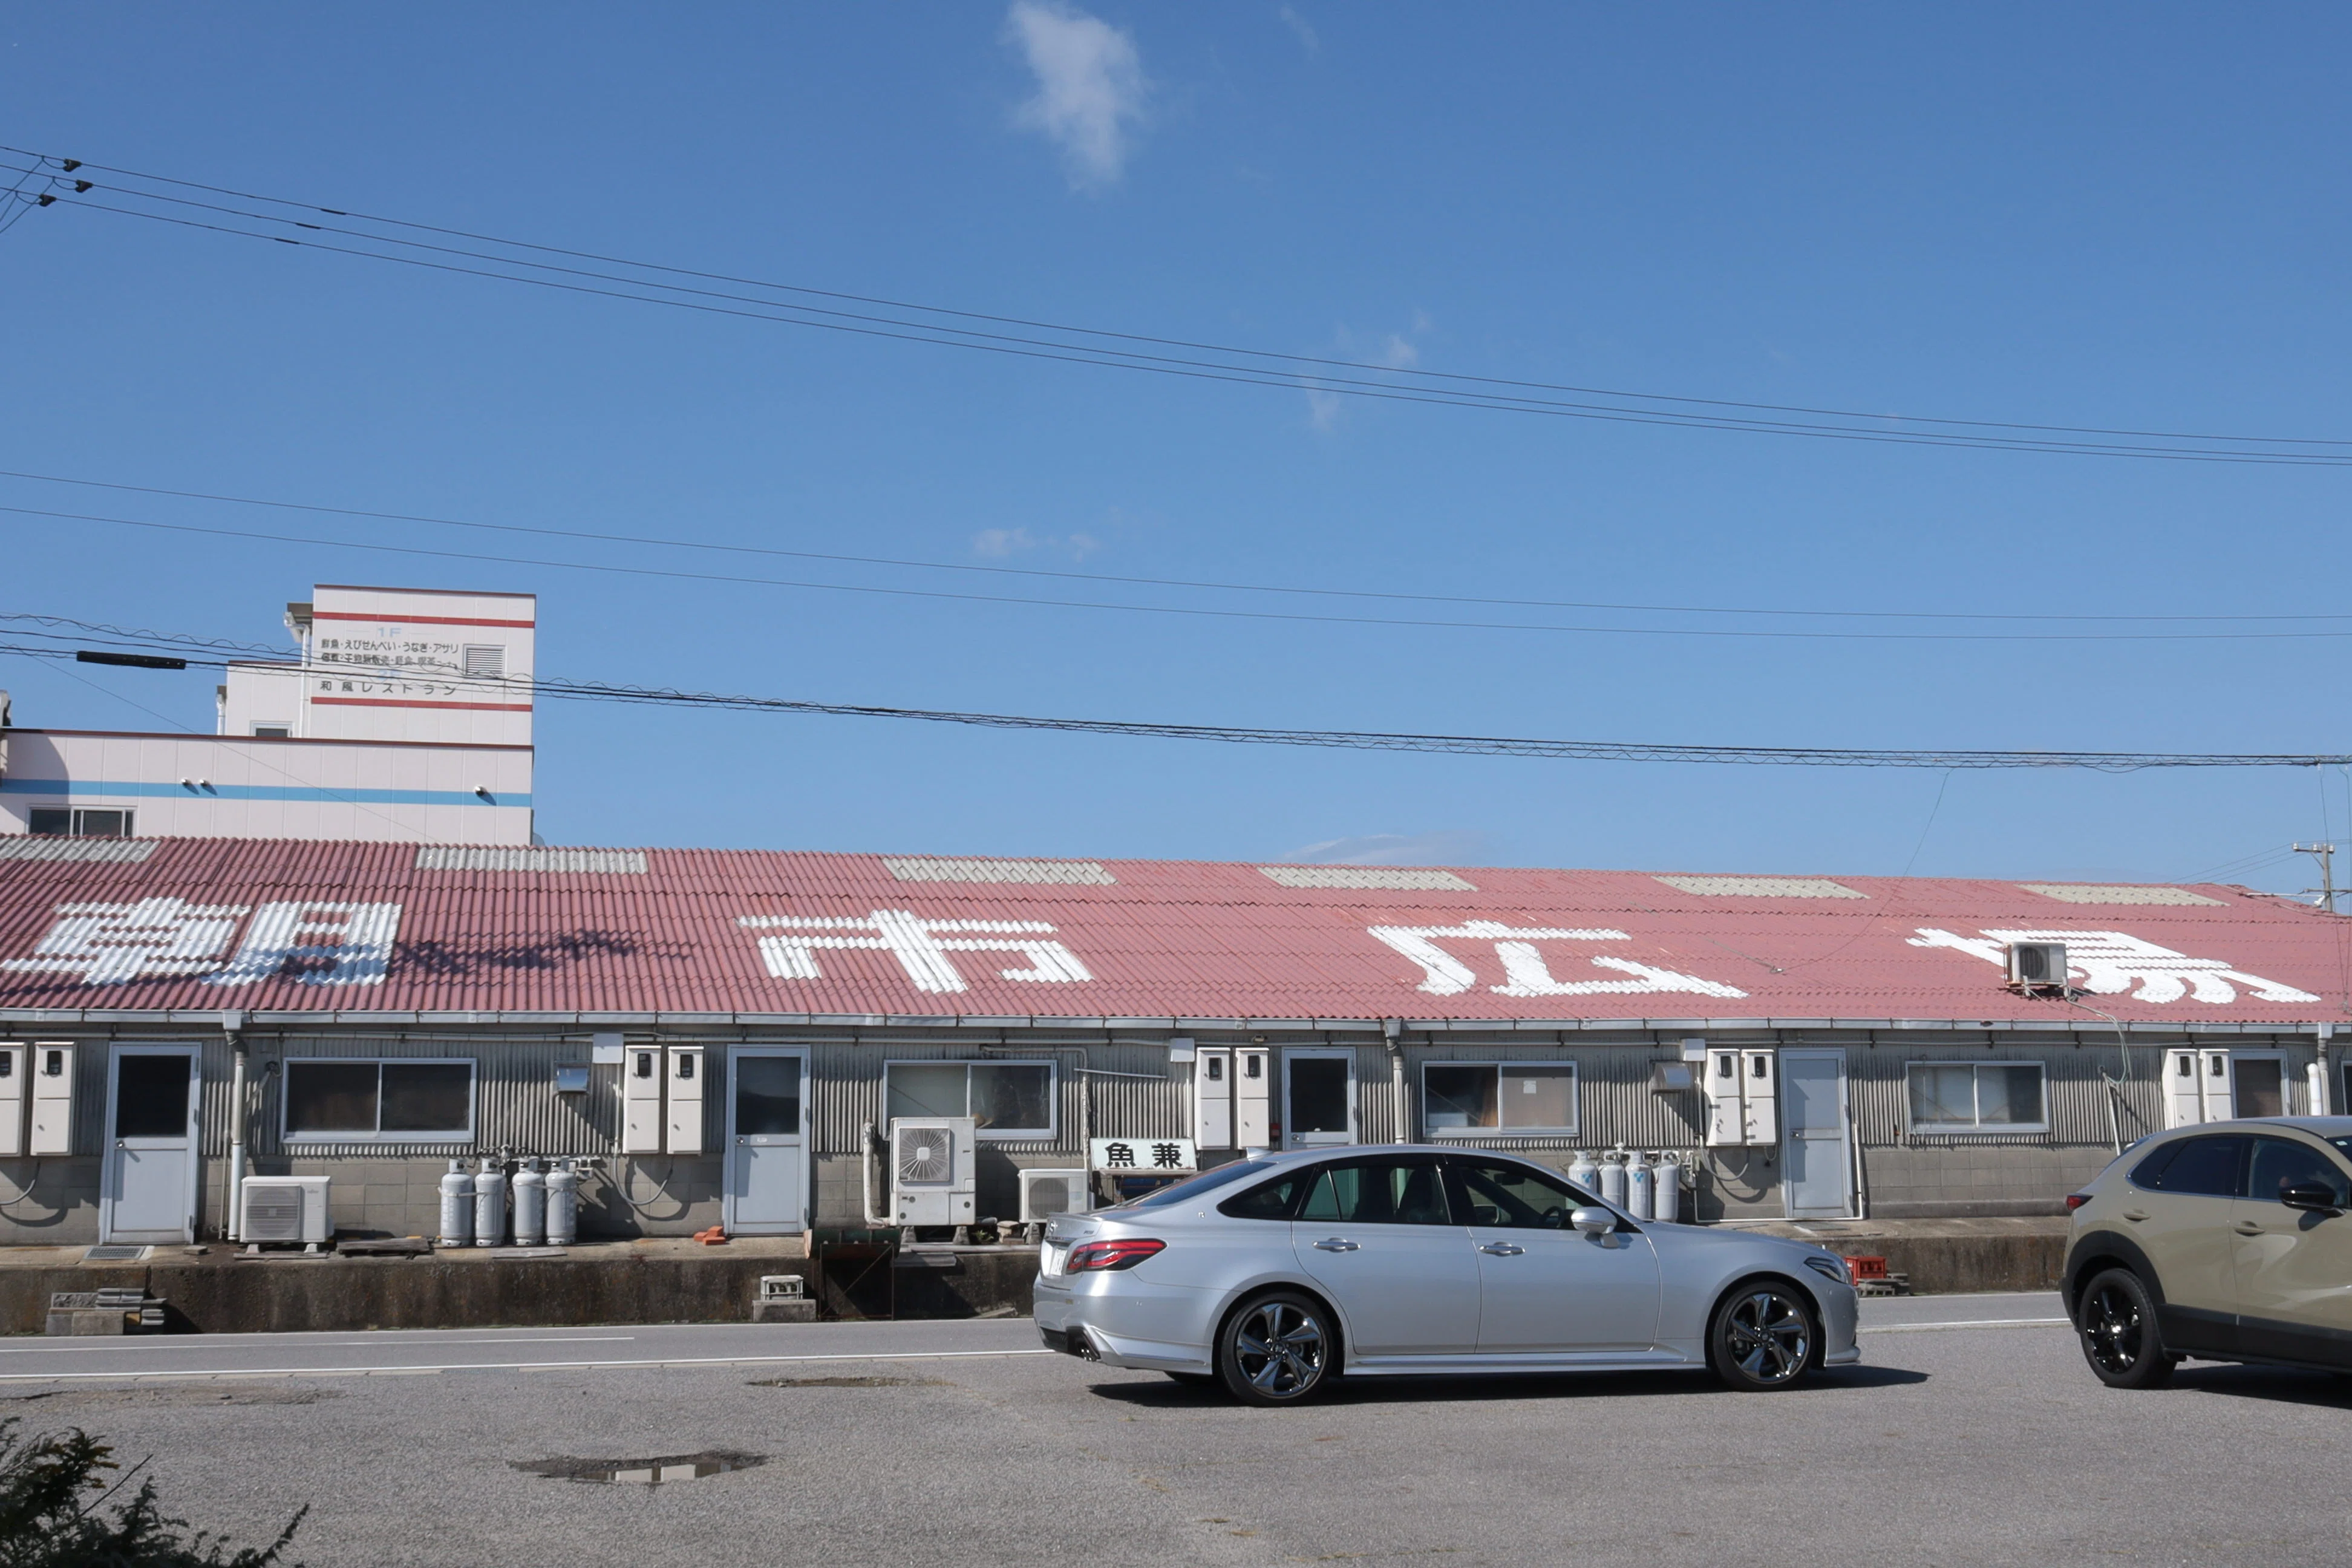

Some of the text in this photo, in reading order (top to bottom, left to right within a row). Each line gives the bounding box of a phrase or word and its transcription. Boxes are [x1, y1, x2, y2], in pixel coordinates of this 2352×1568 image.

[377, 627, 402, 638] 1F
[320, 681, 456, 696] 和風レストラン
[1105, 1142, 1183, 1169] 魚兼
